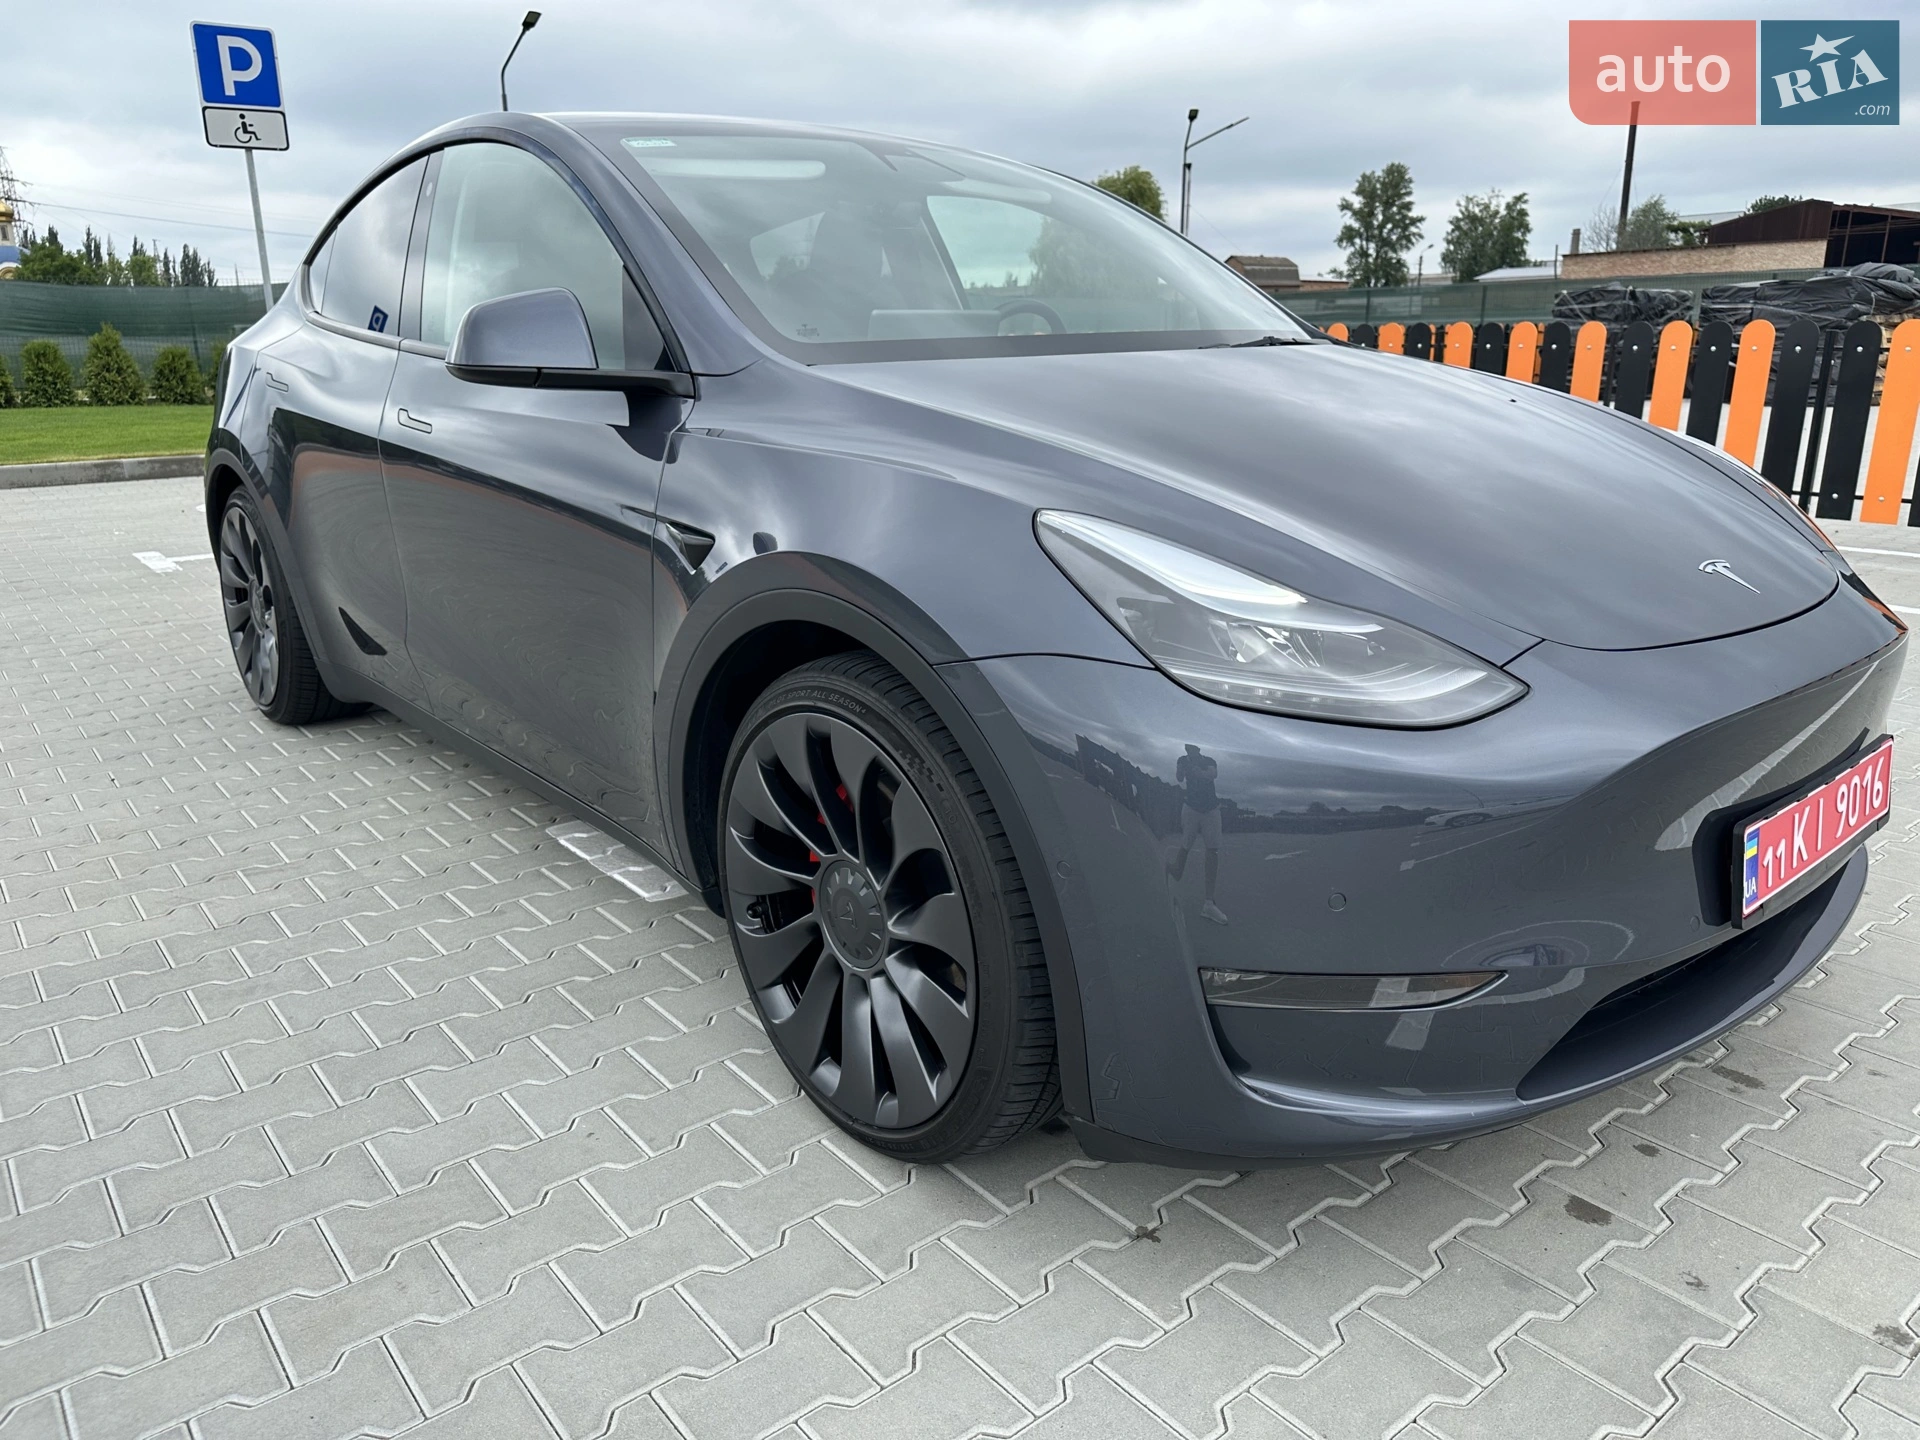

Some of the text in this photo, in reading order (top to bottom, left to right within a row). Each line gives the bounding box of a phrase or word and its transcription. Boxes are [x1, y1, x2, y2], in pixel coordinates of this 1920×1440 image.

[216, 35, 263, 96] P
[811, 689, 826, 699] ALL
[1836, 756, 1885, 839] 9016
[1745, 876, 1757, 899] UA
